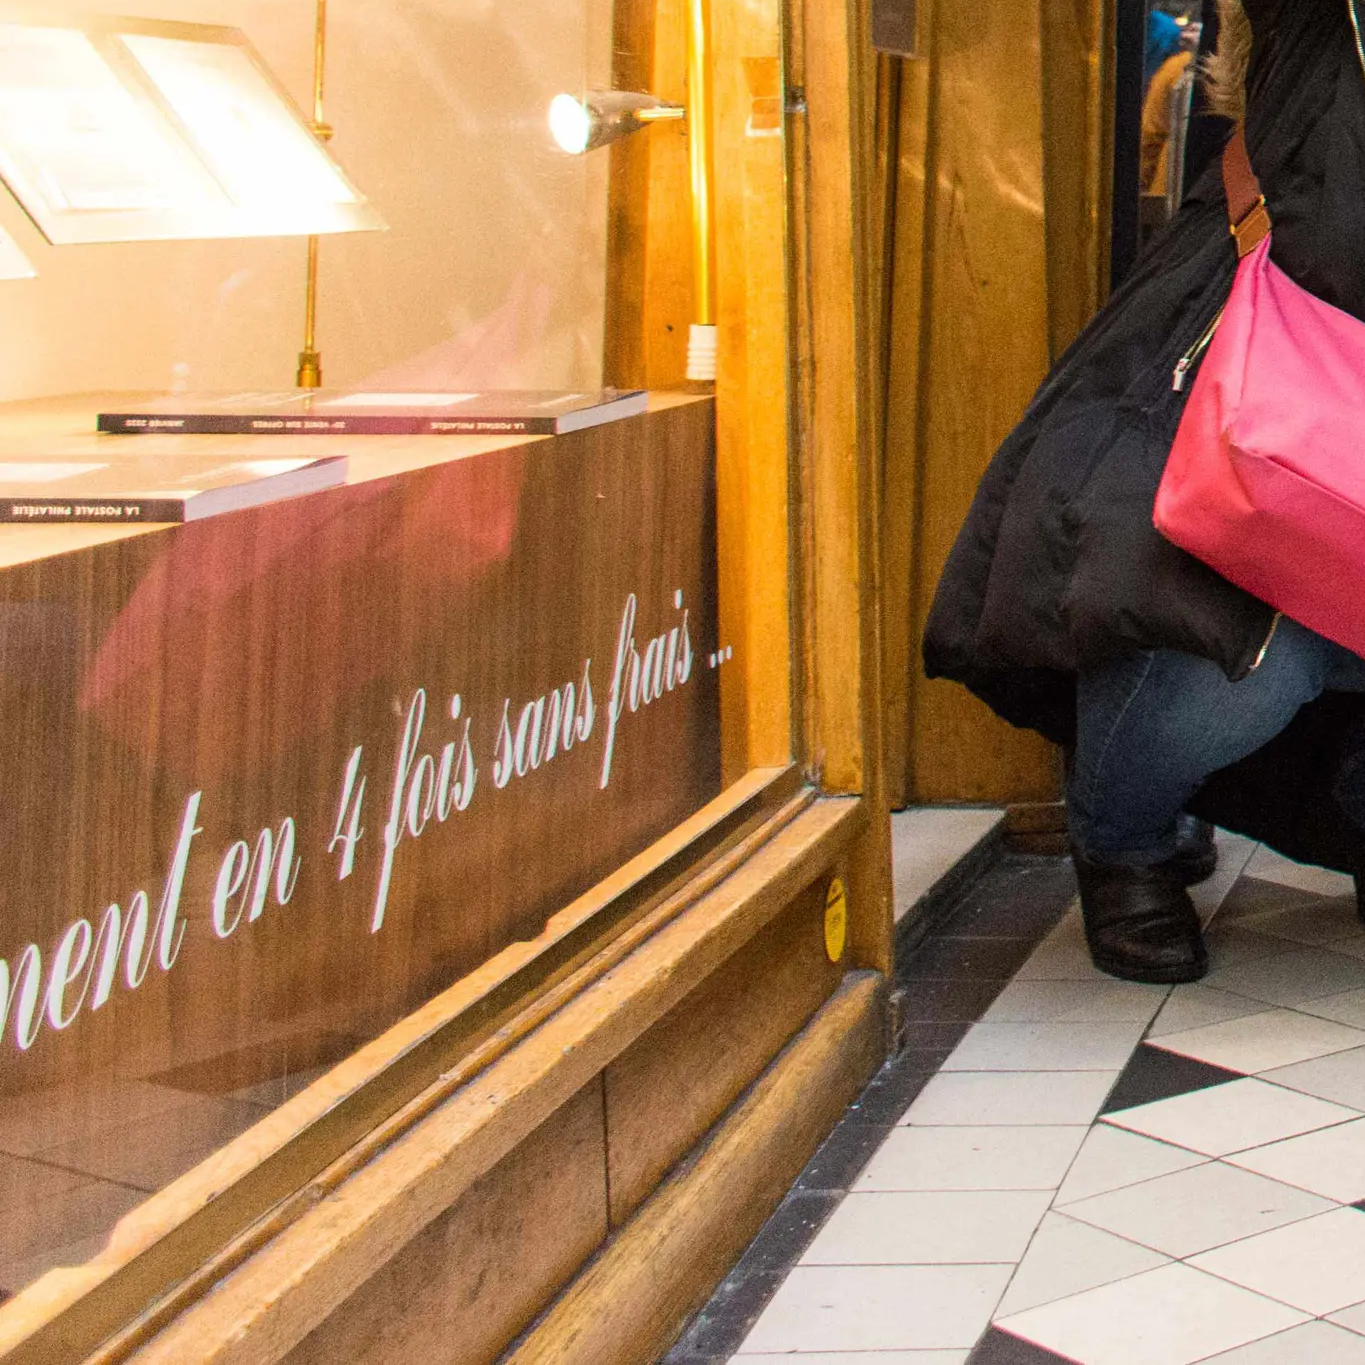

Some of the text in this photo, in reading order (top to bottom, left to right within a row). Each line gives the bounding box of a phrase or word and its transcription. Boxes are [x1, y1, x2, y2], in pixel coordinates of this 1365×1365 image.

[12, 506, 71, 517] PHILATÉLIE
[74, 506, 122, 516] POSTALE
[212, 816, 301, 939] en
[329, 745, 366, 882] 4
[371, 688, 478, 934] fois
[494, 658, 597, 790] sans
[600, 589, 694, 790] frais
